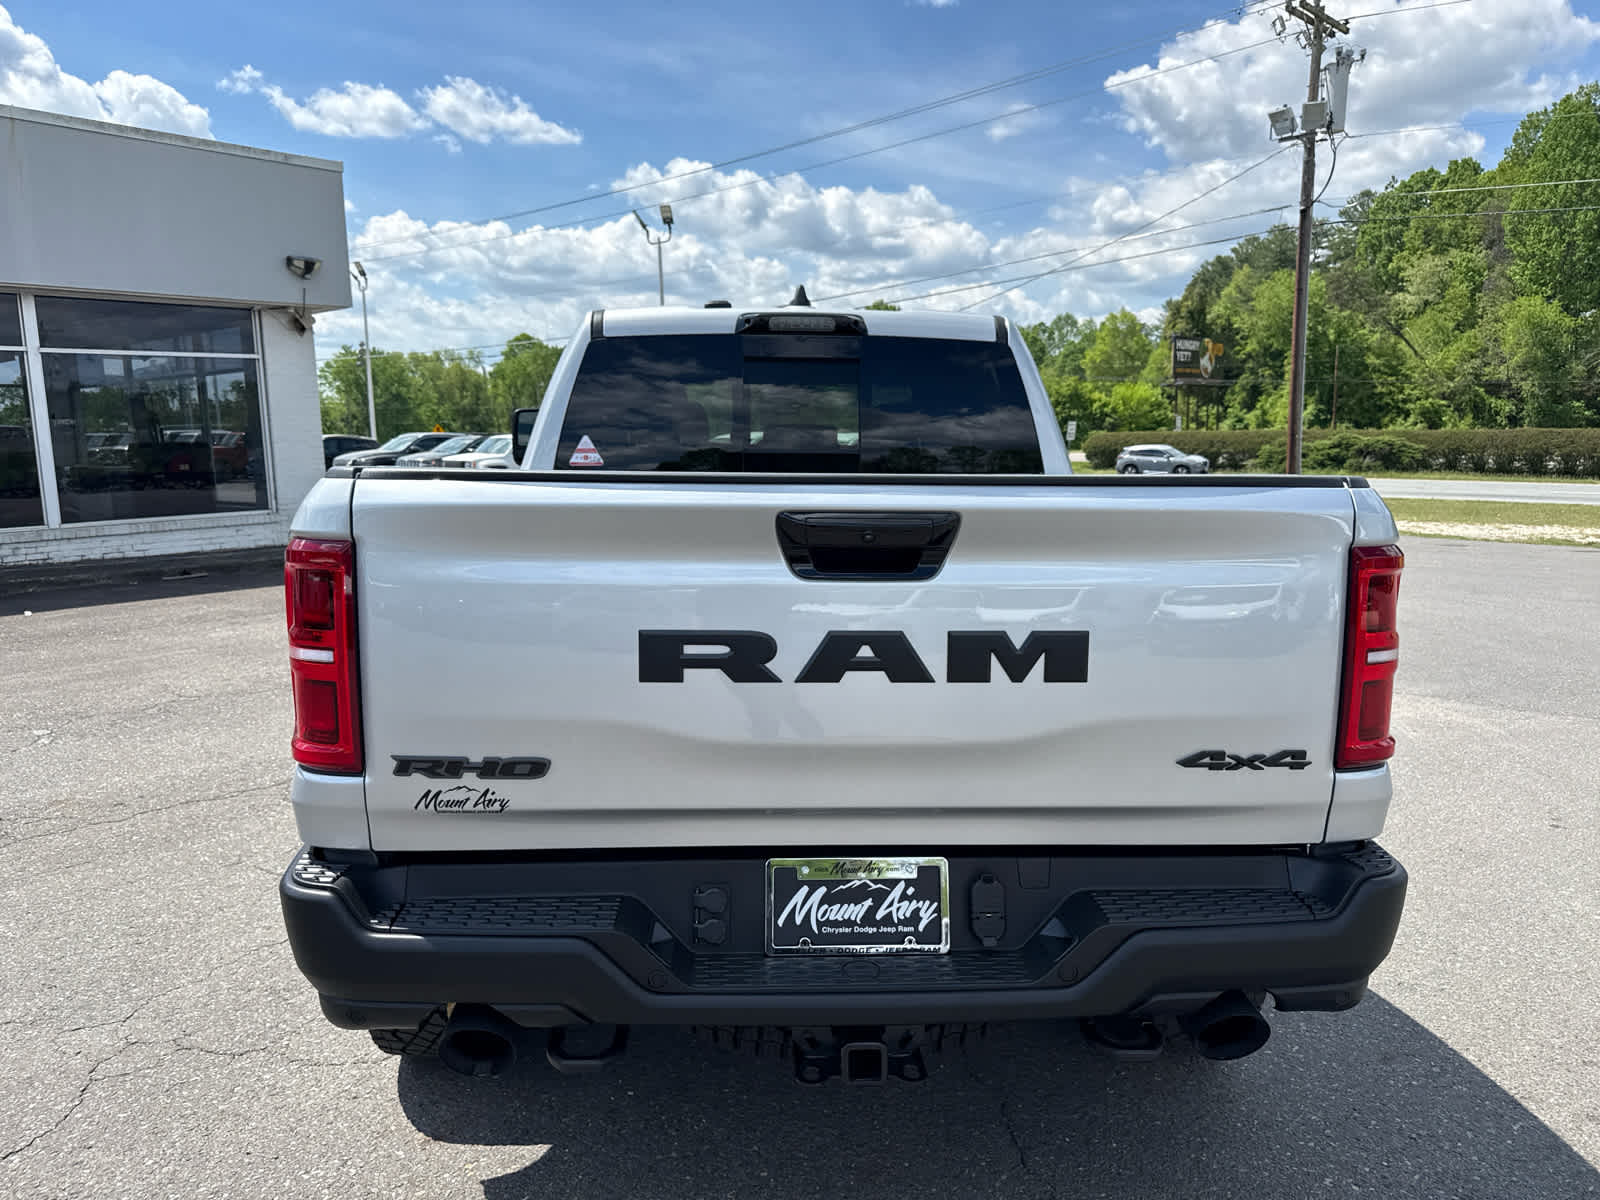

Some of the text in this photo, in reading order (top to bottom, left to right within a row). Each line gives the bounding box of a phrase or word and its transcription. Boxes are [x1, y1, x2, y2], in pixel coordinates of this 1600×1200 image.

[638, 629, 1090, 684] RAM
[390, 754, 552, 780] RHO
[1175, 749, 1312, 771] 4x4
[414, 787, 511, 814] Mount Airy
[830, 861, 863, 876] Mount
[863, 860, 884, 877] Airy
[777, 880, 938, 935] Mount Airy
[821, 925, 915, 935] Chrysler Dodge Jeep Ram
